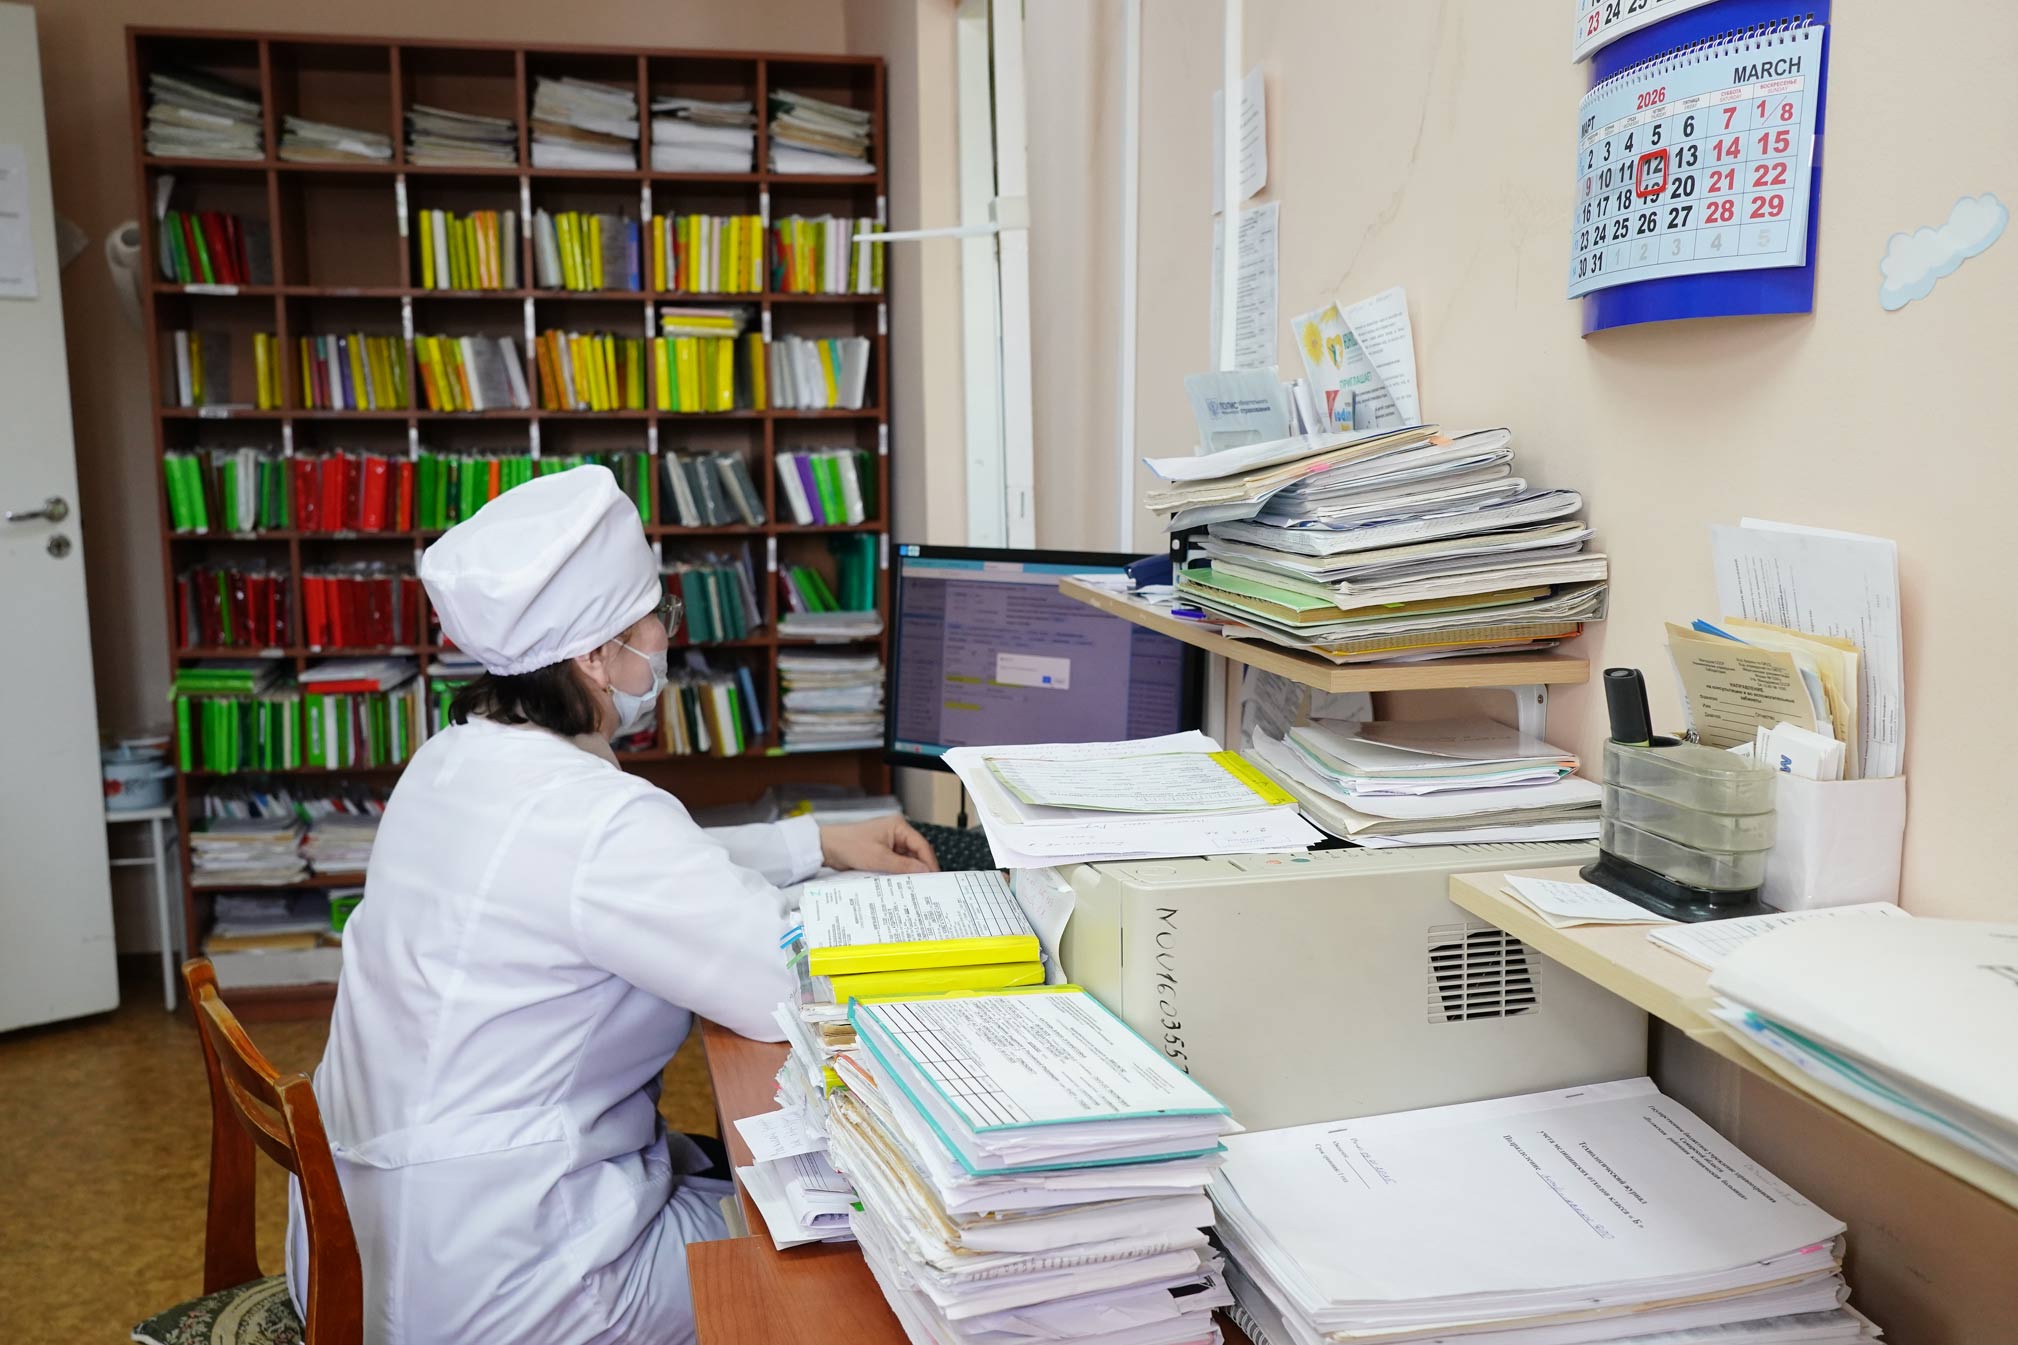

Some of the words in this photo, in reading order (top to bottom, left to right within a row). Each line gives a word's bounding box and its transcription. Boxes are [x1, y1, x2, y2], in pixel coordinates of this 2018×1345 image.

[1587, 10, 1600, 37] 23
[1604, 1, 1620, 26] 24
[1720, 88, 1741, 97] СУББОТА
[1760, 79, 1797, 89] ВОСКРЕСЕНЬЕ
[1733, 56, 1801, 84] MARCH
[1636, 86, 1666, 110] 2026
[1581, 115, 1596, 138] МАРТ
[1587, 149, 1593, 169] 2
[1604, 141, 1611, 161] 3
[1624, 132, 1634, 152] 4
[1651, 124, 1662, 145] 5
[1683, 115, 1694, 137] 6
[1723, 106, 1737, 129] 7
[1586, 177, 1591, 196] 9
[1598, 168, 1612, 190] 10
[1619, 160, 1634, 183] 11
[1645, 156, 1663, 176] 12
[1675, 144, 1698, 169] 13
[1712, 137, 1740, 162] 14
[1757, 130, 1790, 155] 15
[1583, 203, 1591, 224] 16
[1597, 196, 1610, 218] 17
[1617, 189, 1632, 211] 18
[1643, 182, 1660, 205] 19
[1670, 175, 1695, 199] 20
[1707, 168, 1736, 193] 21
[1752, 162, 1787, 187] 22
[1580, 230, 1589, 252] 23
[1593, 224, 1606, 246] 24
[1612, 217, 1630, 240] 25
[1637, 211, 1657, 235] 26
[1667, 205, 1693, 229] 27
[1704, 199, 1735, 224] 28
[1749, 194, 1784, 219] 29
[1578, 257, 1587, 278] 30
[1591, 251, 1603, 273] 31
[1640, 243, 1648, 260] 2
[1672, 238, 1681, 256] 3
[1710, 233, 1722, 251] 4
[1757, 229, 1771, 248] 5
[1503, 1134, 1542, 1171] Подразделение
[1536, 1130, 1556, 1144] учета
[1554, 1143, 1589, 1177] медицинских
[1587, 1176, 1611, 1197] отходов
[1608, 1196, 1630, 1215] класса
[1578, 1140, 1627, 1185] Технологический
[1623, 1184, 1648, 1205] журнал
